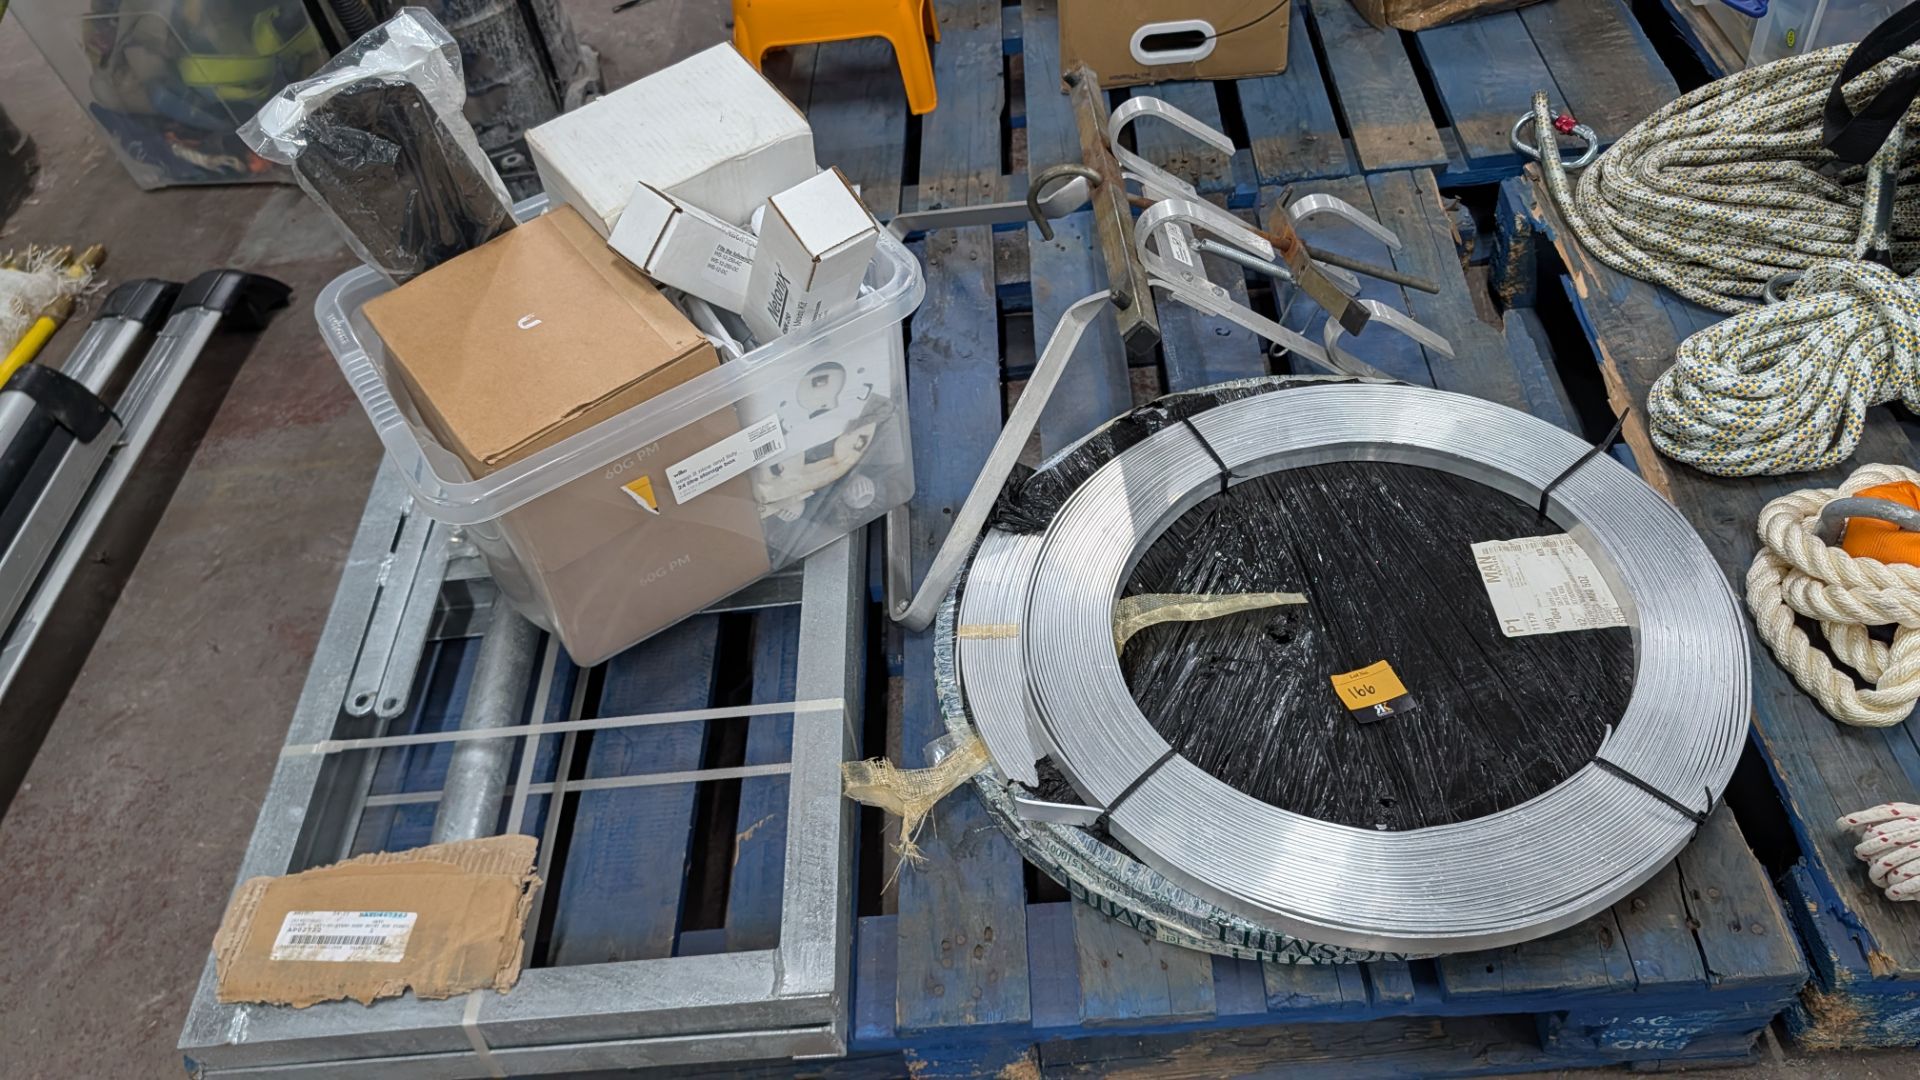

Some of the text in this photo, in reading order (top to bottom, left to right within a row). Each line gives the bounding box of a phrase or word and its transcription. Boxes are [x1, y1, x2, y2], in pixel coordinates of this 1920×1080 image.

[767, 261, 791, 323] Netonix
[604, 442, 660, 480] 60G PM
[699, 465, 723, 479] storage
[669, 554, 691, 572] PM
[1347, 684, 1376, 699] 166
